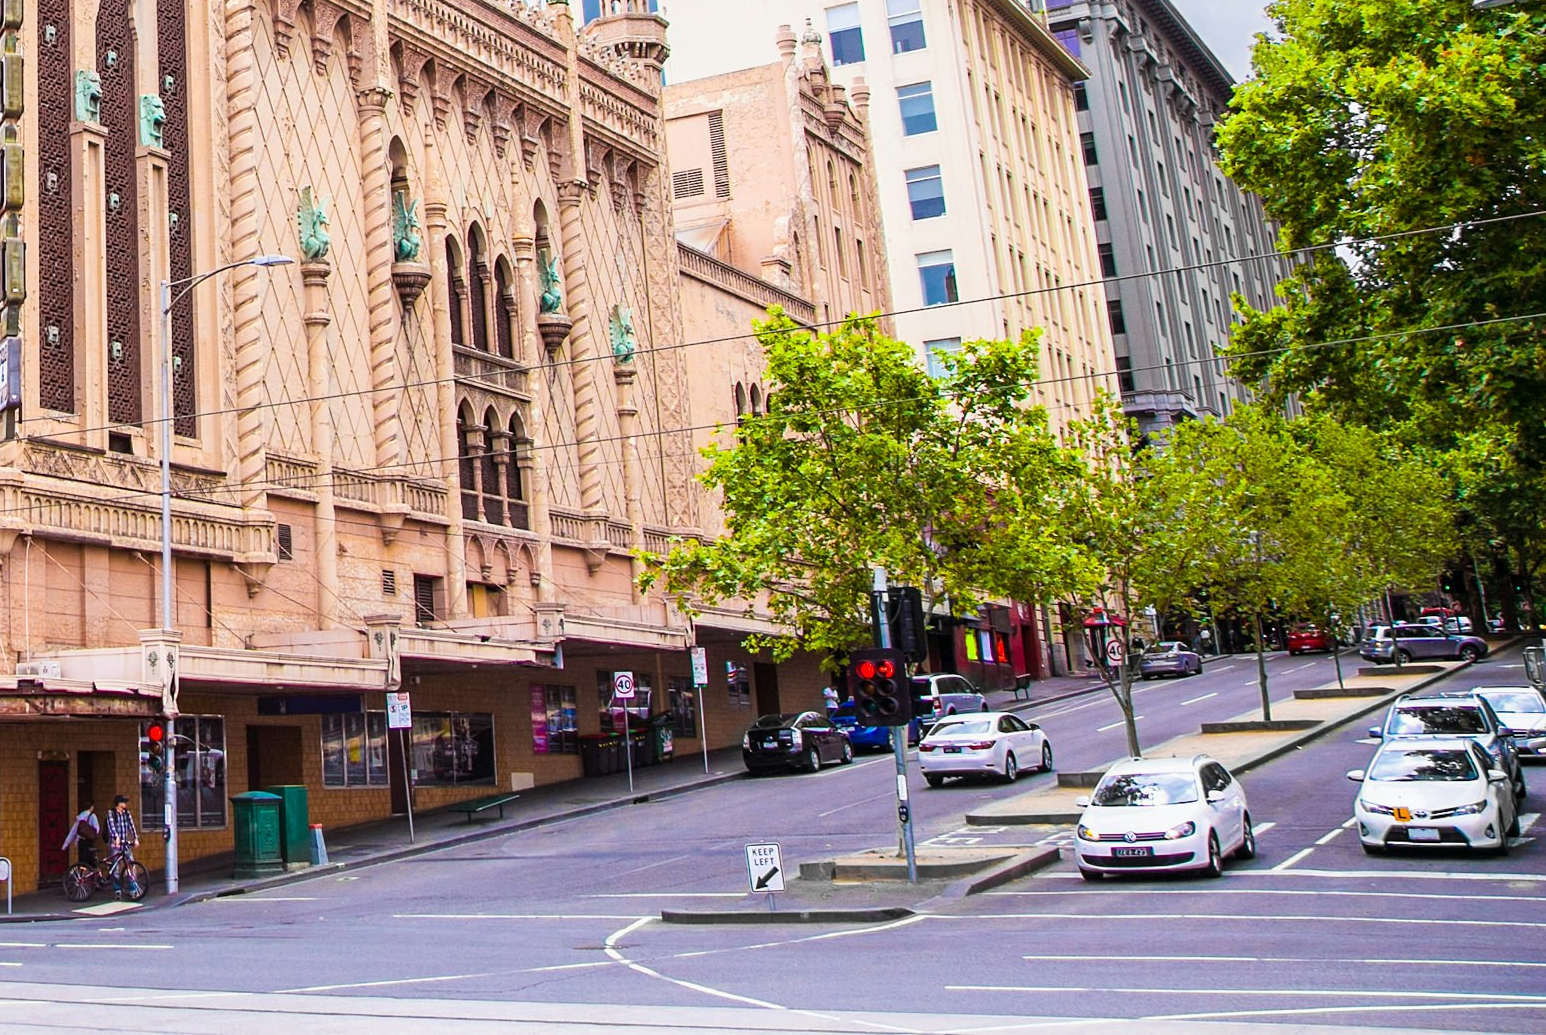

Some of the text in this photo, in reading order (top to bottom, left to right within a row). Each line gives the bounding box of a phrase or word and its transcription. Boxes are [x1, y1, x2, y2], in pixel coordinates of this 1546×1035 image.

[617, 679, 631, 690] 40
[1397, 807, 1407, 819] L
[752, 848, 774, 856] KEEP
[754, 858, 774, 866] LEFT
